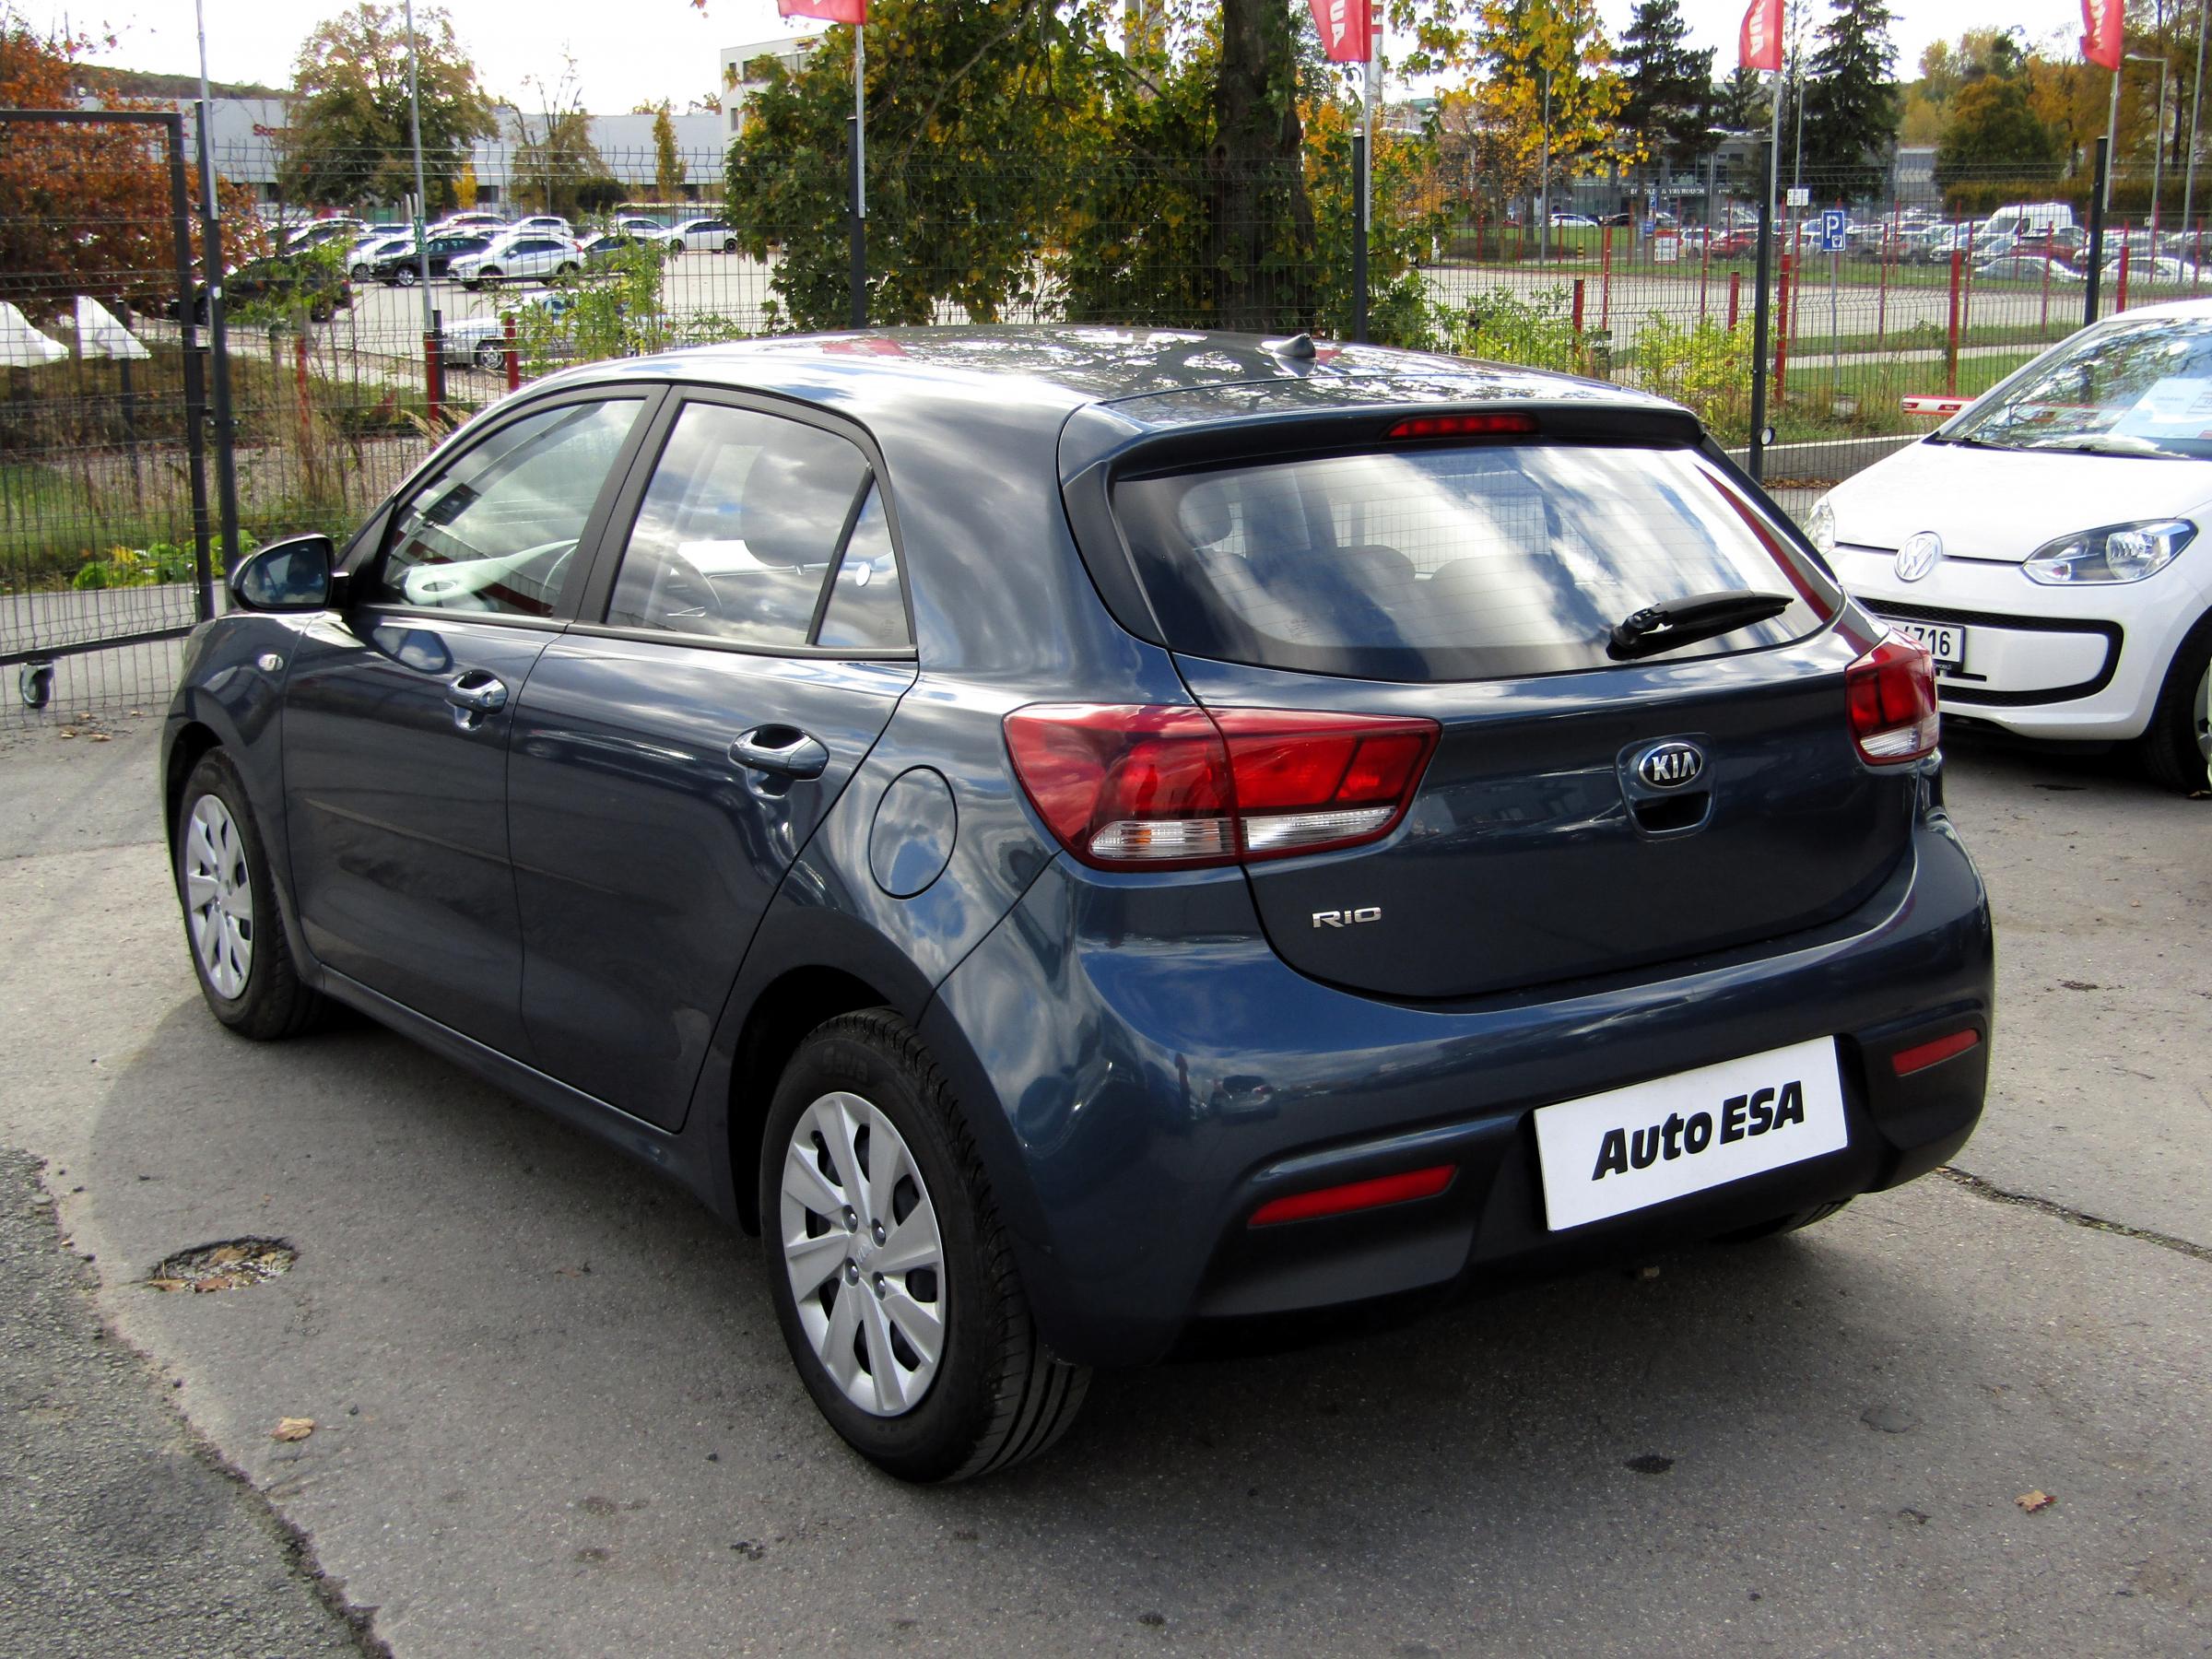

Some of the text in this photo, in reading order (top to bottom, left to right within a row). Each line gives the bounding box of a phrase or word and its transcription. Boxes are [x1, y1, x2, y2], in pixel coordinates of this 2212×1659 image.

[1826, 215, 1840, 240] P
[1904, 626, 1951, 656] 716
[1651, 751, 1696, 782] KIA
[1312, 906, 1382, 928] RIO
[1592, 1080, 1805, 1181] Auto ESA
